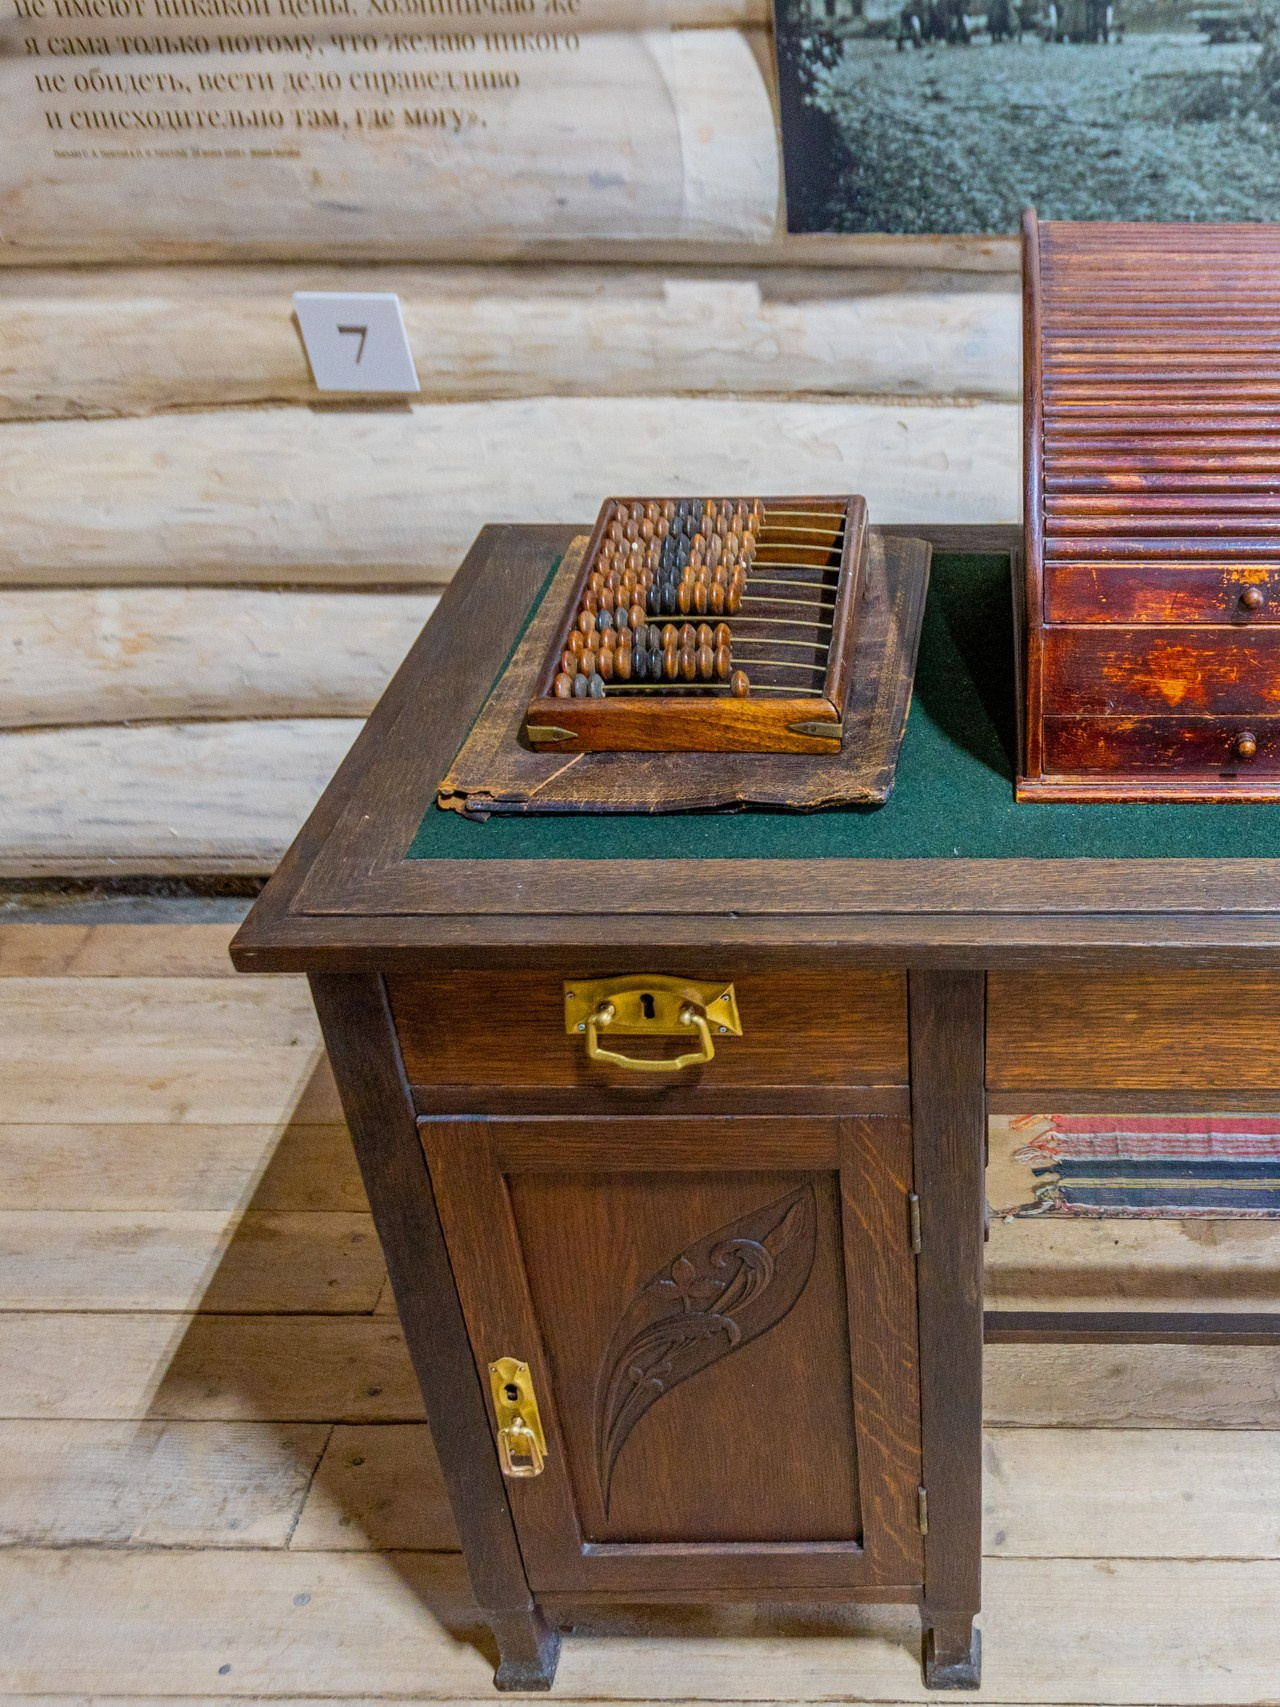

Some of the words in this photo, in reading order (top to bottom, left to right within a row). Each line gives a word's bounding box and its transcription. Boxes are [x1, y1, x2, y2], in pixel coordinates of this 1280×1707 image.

[56, 0, 148, 18] имеют
[24, 36, 41, 56] я
[47, 36, 111, 56] сама
[115, 35, 210, 55] только
[215, 34, 323, 59] потому,
[329, 33, 379, 53] что
[386, 32, 477, 53] желаю
[484, 31, 580, 53] никого
[34, 73, 66, 93] не
[73, 67, 192, 96] обидеть,
[198, 72, 276, 93] вести
[282, 71, 342, 94] дело
[349, 70, 521, 97] справедливо
[45, 109, 64, 130] и
[69, 109, 285, 132] снисходительно
[289, 108, 349, 130] там,
[353, 108, 396, 130] где
[336, 324, 368, 365] 7
